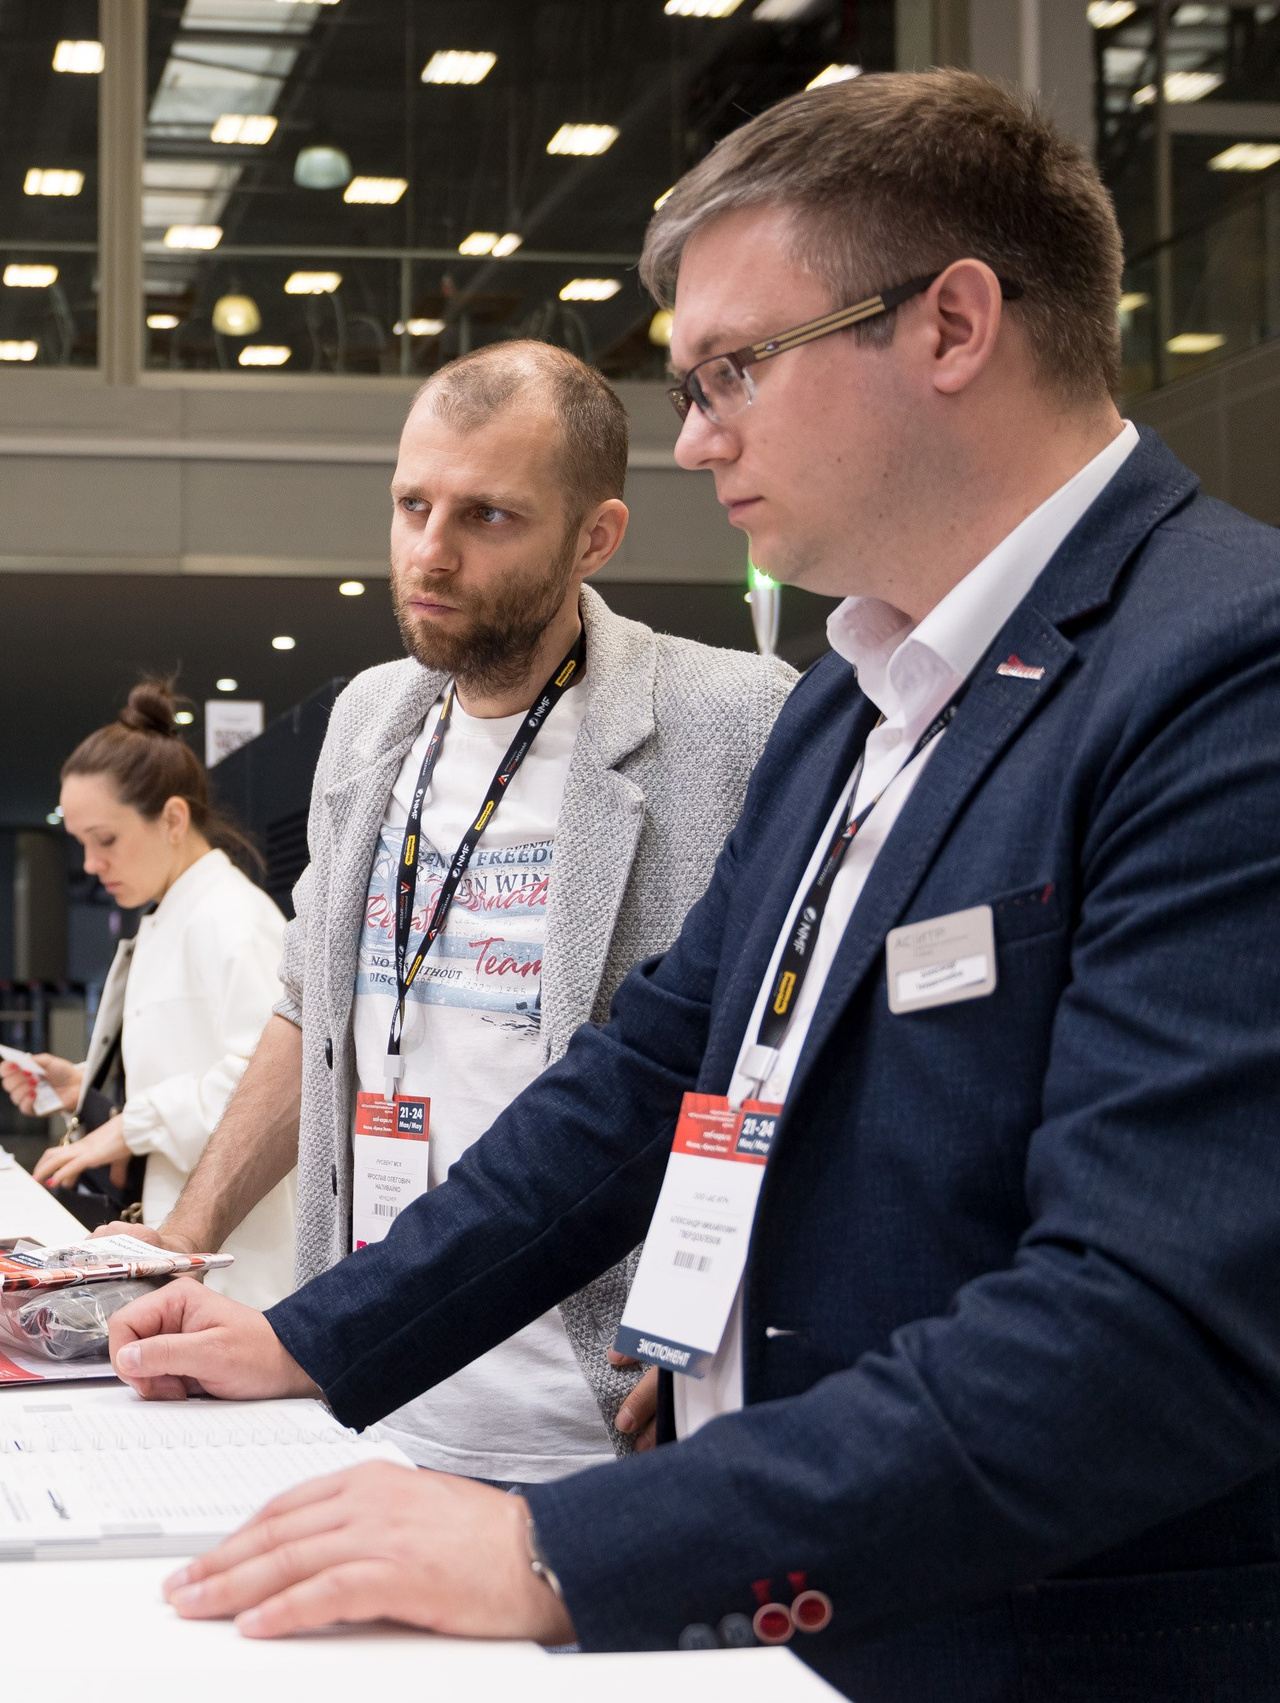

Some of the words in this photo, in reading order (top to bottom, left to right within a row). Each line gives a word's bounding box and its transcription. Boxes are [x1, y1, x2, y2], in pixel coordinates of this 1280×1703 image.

[534, 696, 550, 718] NMF
[456, 843, 471, 867] NMF
[792, 921, 812, 957] NMF
[371, 955, 390, 968] NO
[417, 964, 464, 981] ITHOUT
[399, 1106, 423, 1120] 21-24
[637, 1338, 692, 1368] ЭКСПОНЕНТ
